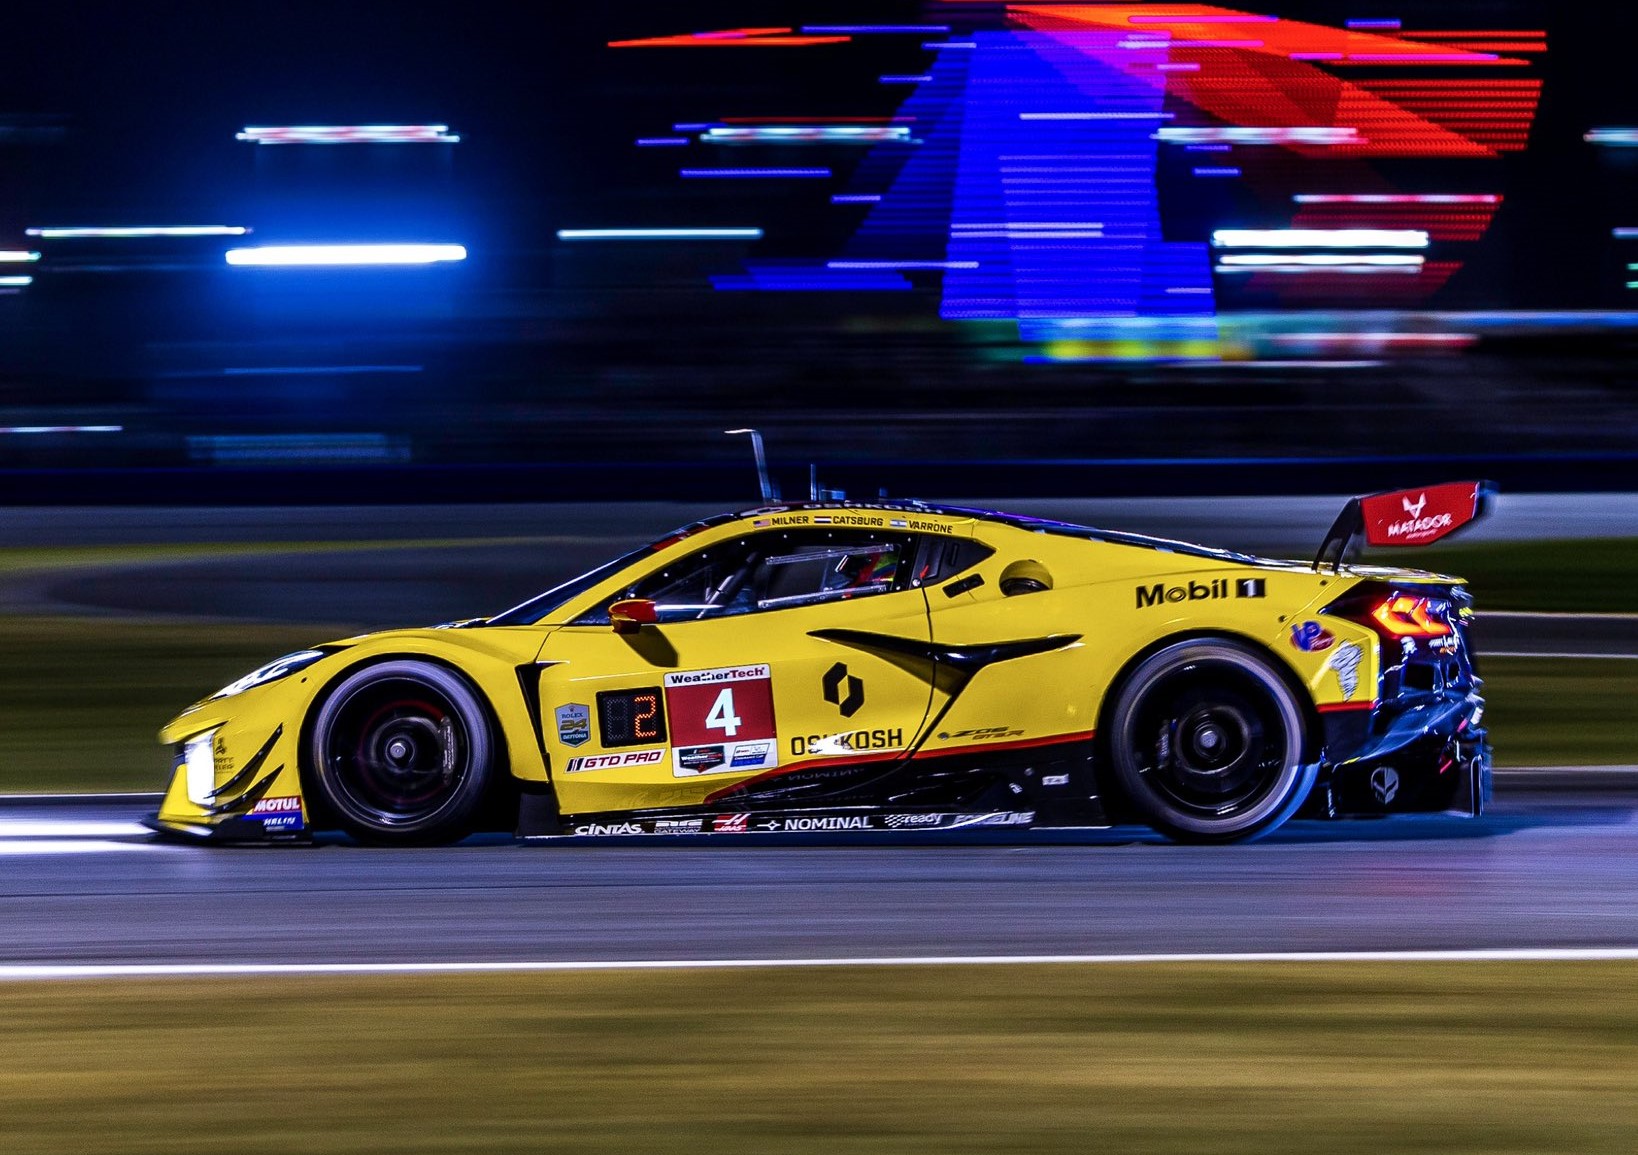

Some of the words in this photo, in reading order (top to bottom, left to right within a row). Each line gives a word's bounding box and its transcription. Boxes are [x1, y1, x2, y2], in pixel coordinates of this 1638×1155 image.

[771, 516, 809, 526] MILNER
[832, 516, 884, 527] CATSBURG
[909, 520, 953, 534] VARRONE
[1387, 513, 1453, 537] MATADOR
[1135, 578, 1228, 609] Mobil
[634, 695, 657, 738] 2
[704, 687, 742, 737] 4
[560, 718, 587, 731] 24
[790, 727, 903, 756] OSKOSH
[584, 755, 621, 768] GTD
[623, 751, 662, 764] PRO
[254, 797, 300, 812] MOTUL
[784, 815, 874, 831] NOMINAL
[904, 813, 942, 826] ready
